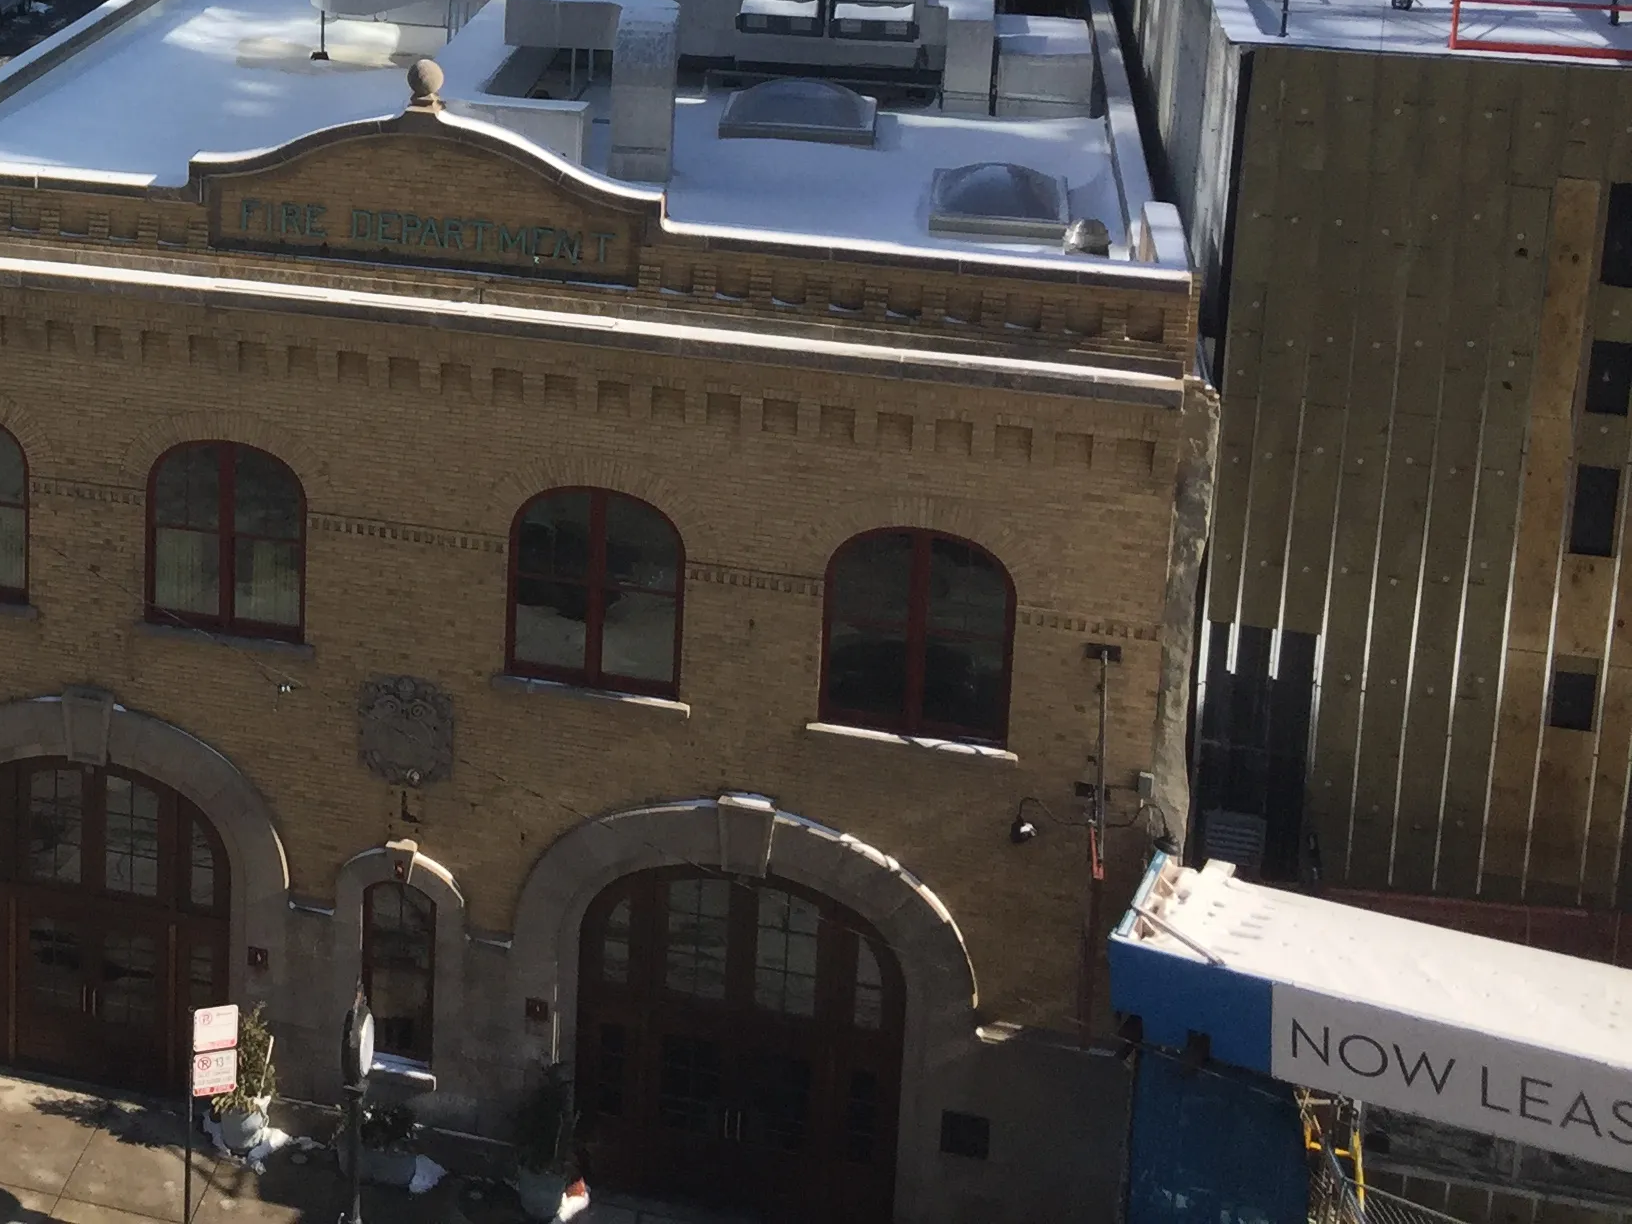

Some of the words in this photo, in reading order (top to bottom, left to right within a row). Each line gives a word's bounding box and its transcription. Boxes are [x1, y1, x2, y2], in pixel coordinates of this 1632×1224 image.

[238, 198, 327, 239] FIRE
[350, 208, 616, 265] DEPARTMENT
[1290, 1018, 1457, 1096] NOW
[1480, 1065, 1632, 1145] LEAS
